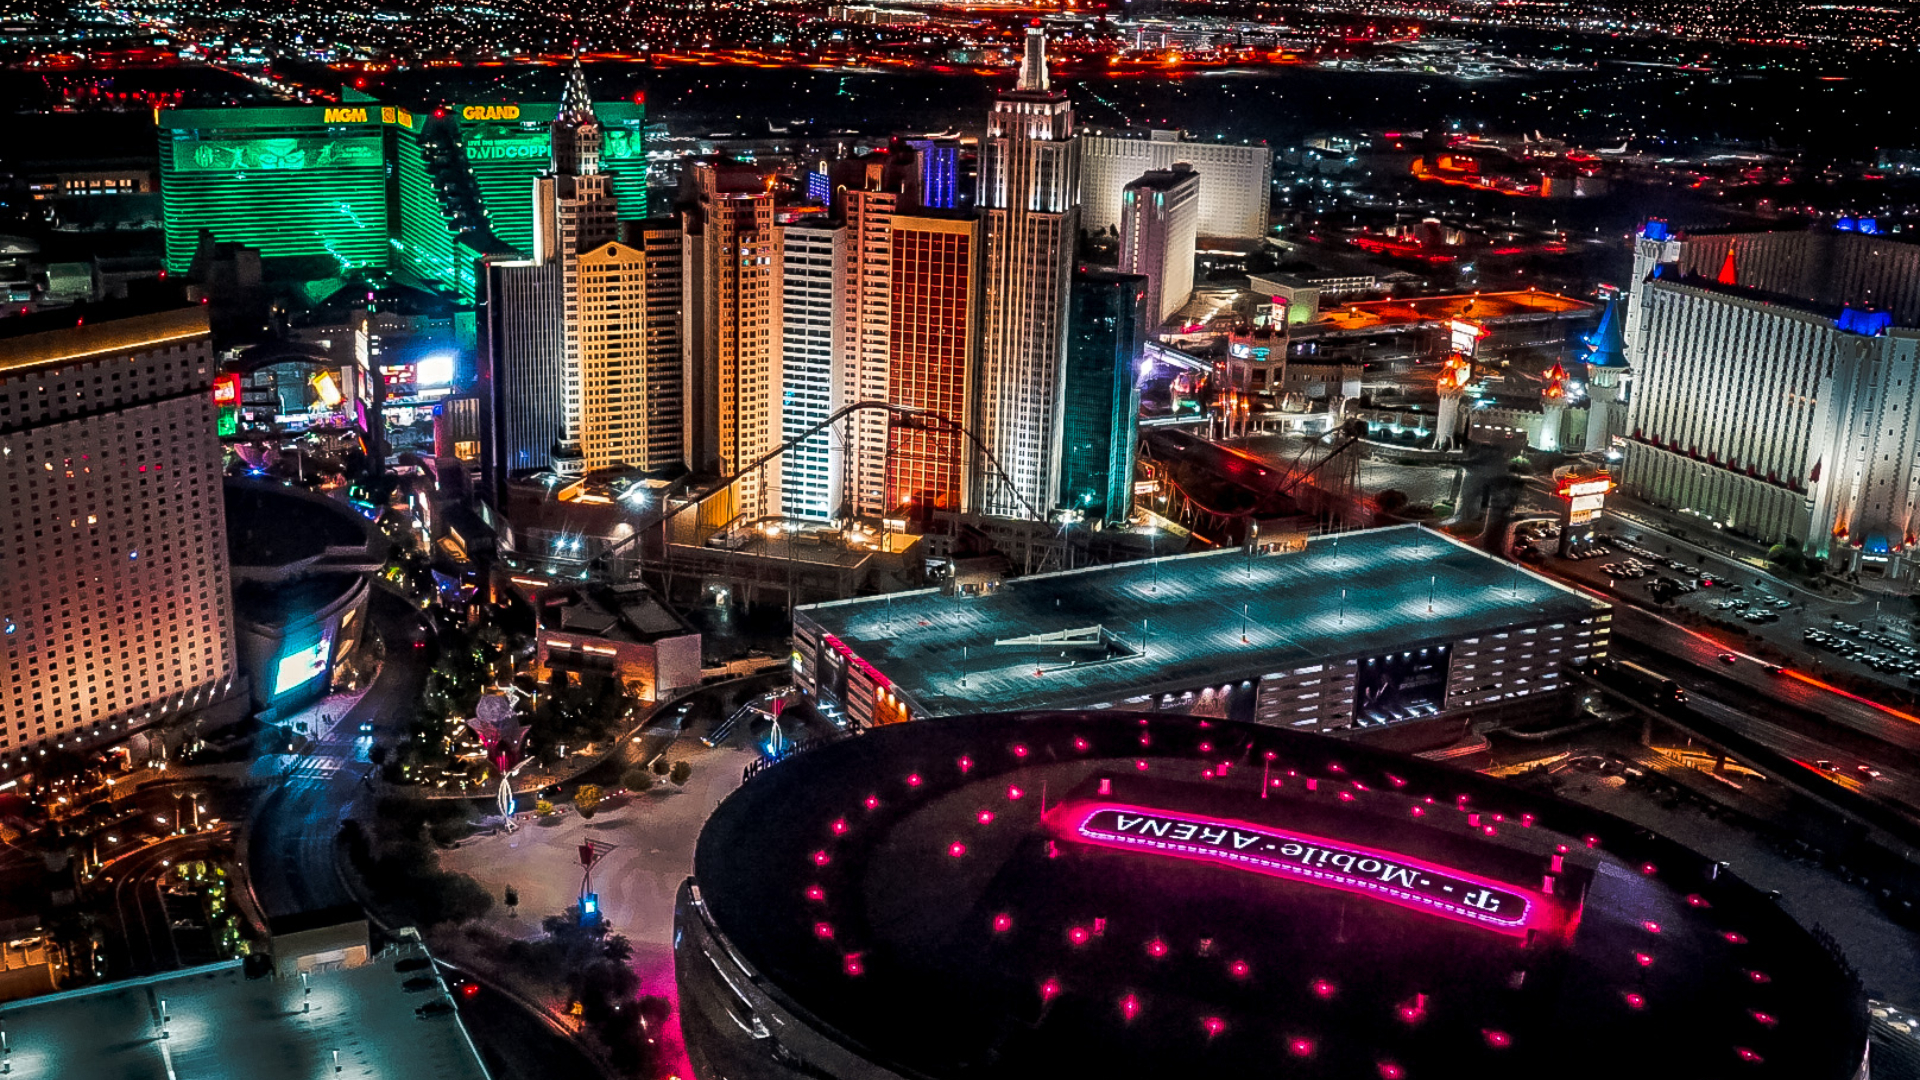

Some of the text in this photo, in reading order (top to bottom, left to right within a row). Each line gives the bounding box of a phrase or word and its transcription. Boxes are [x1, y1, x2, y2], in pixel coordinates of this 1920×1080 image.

[324, 106, 519, 123] MGM GRAND
[1117, 815, 1261, 849] ARENA
